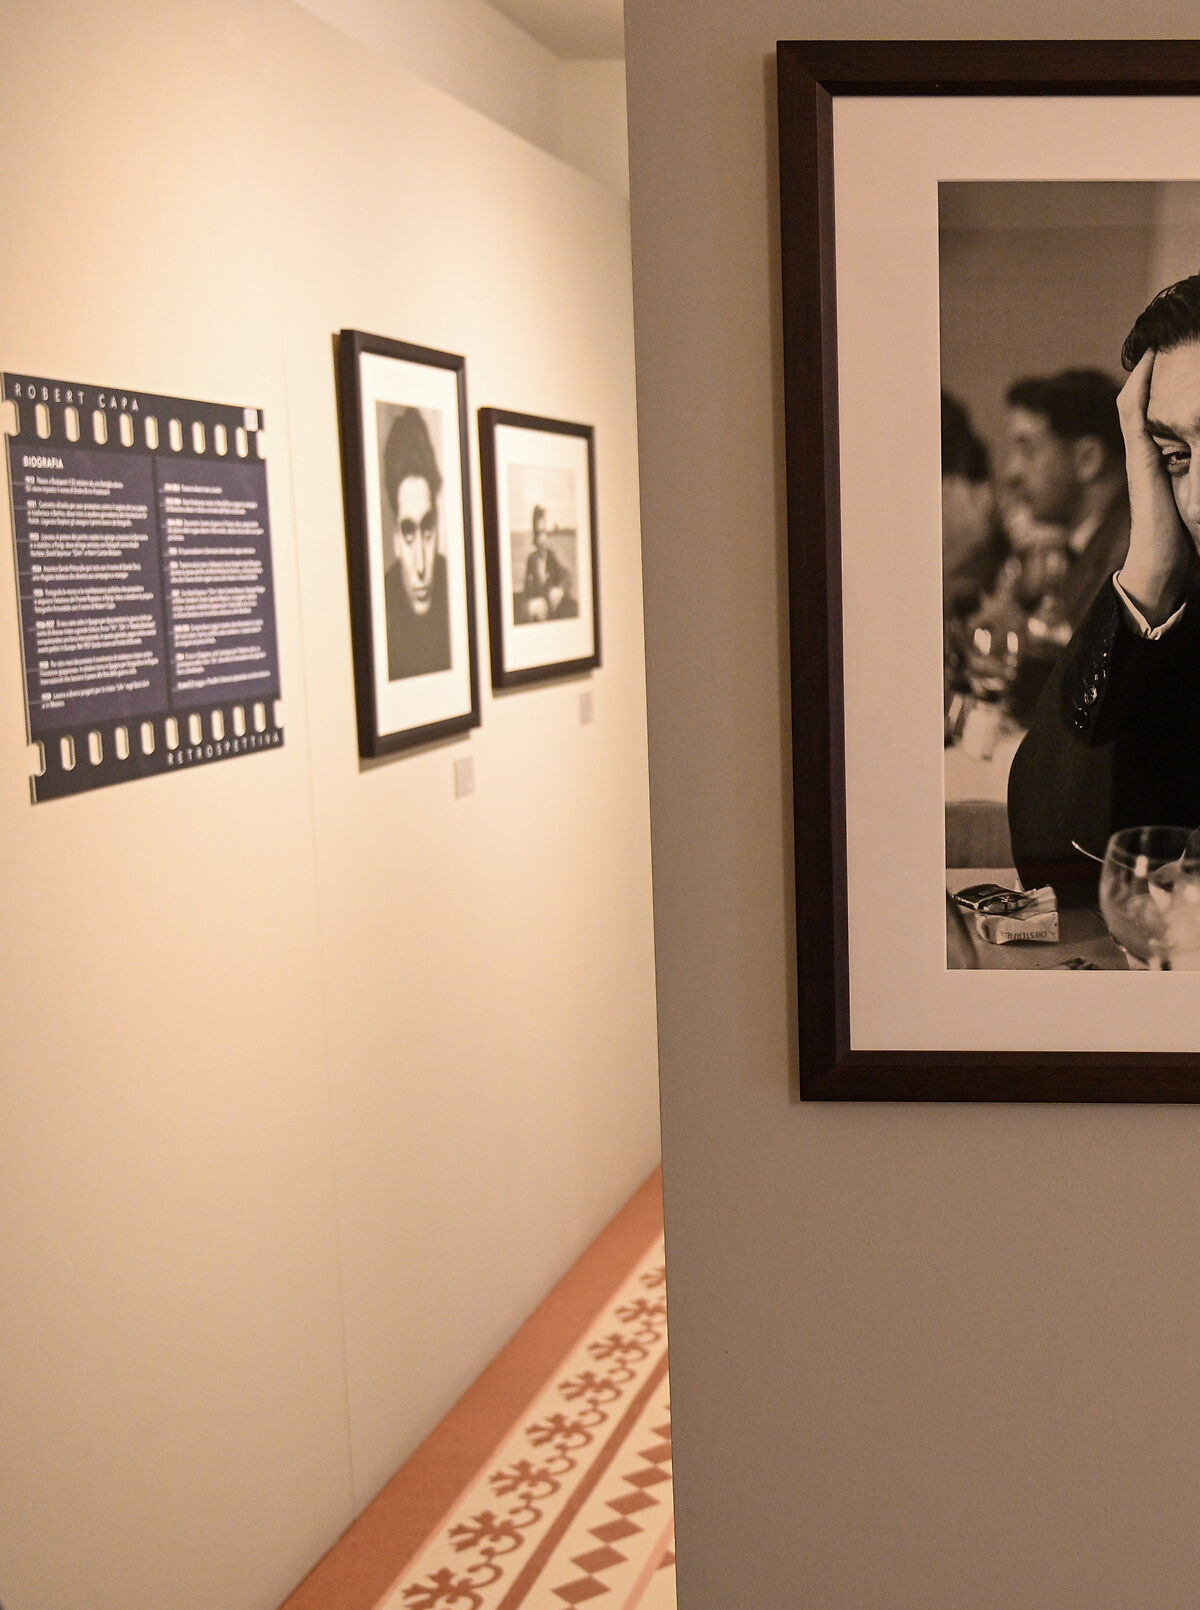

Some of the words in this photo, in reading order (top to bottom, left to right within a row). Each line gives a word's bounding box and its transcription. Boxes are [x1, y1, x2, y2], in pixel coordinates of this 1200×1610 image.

[15, 382, 85, 405] ROBERT
[98, 393, 139, 412] CAPA
[22, 454, 64, 470] BIOGRAFIA
[168, 731, 280, 766] RETROSPETTIVA
